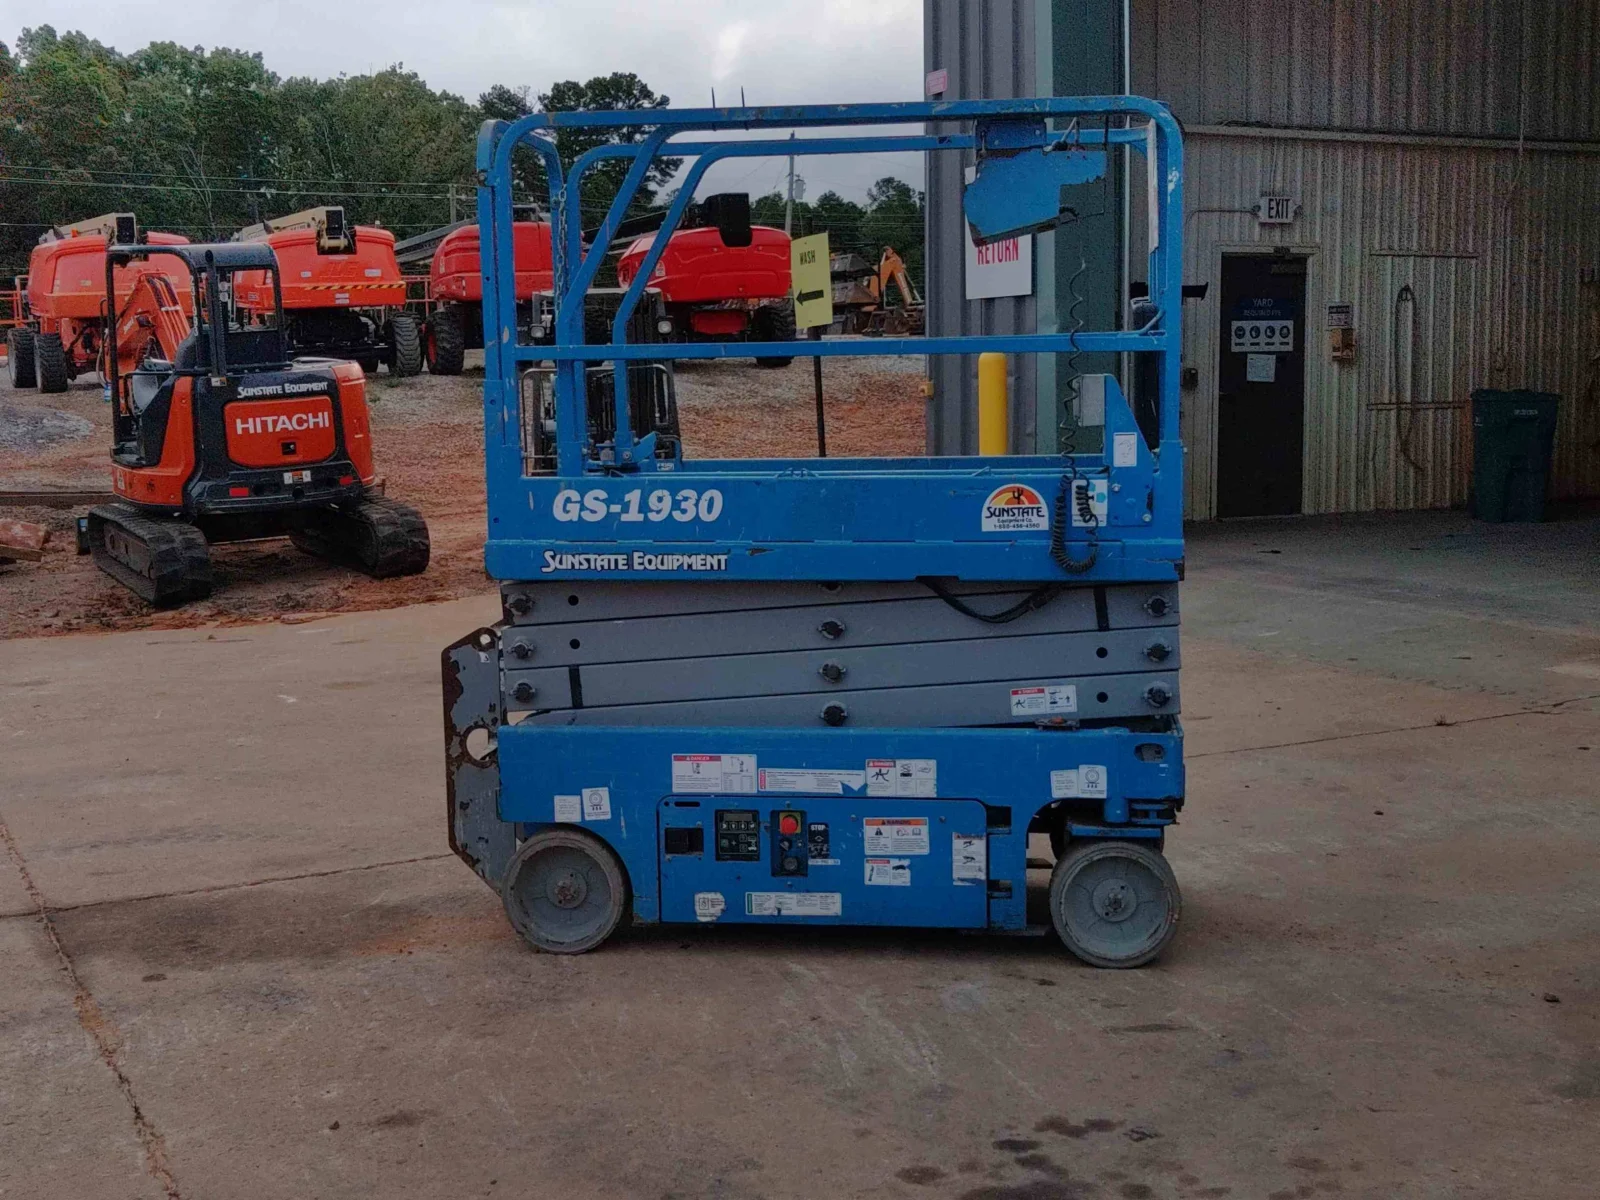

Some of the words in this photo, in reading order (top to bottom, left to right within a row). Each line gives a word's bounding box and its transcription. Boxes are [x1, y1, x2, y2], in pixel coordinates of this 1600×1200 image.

[1267, 198, 1291, 219] EXIT
[799, 249, 816, 266] WASH
[1252, 298, 1274, 307] YARD
[235, 411, 330, 435] HITACHI
[552, 488, 724, 523] GS-1930
[985, 506, 1044, 519] SUNSTATE
[541, 550, 629, 573] SUNSTATE
[632, 550, 728, 572] EQUIPMENT
